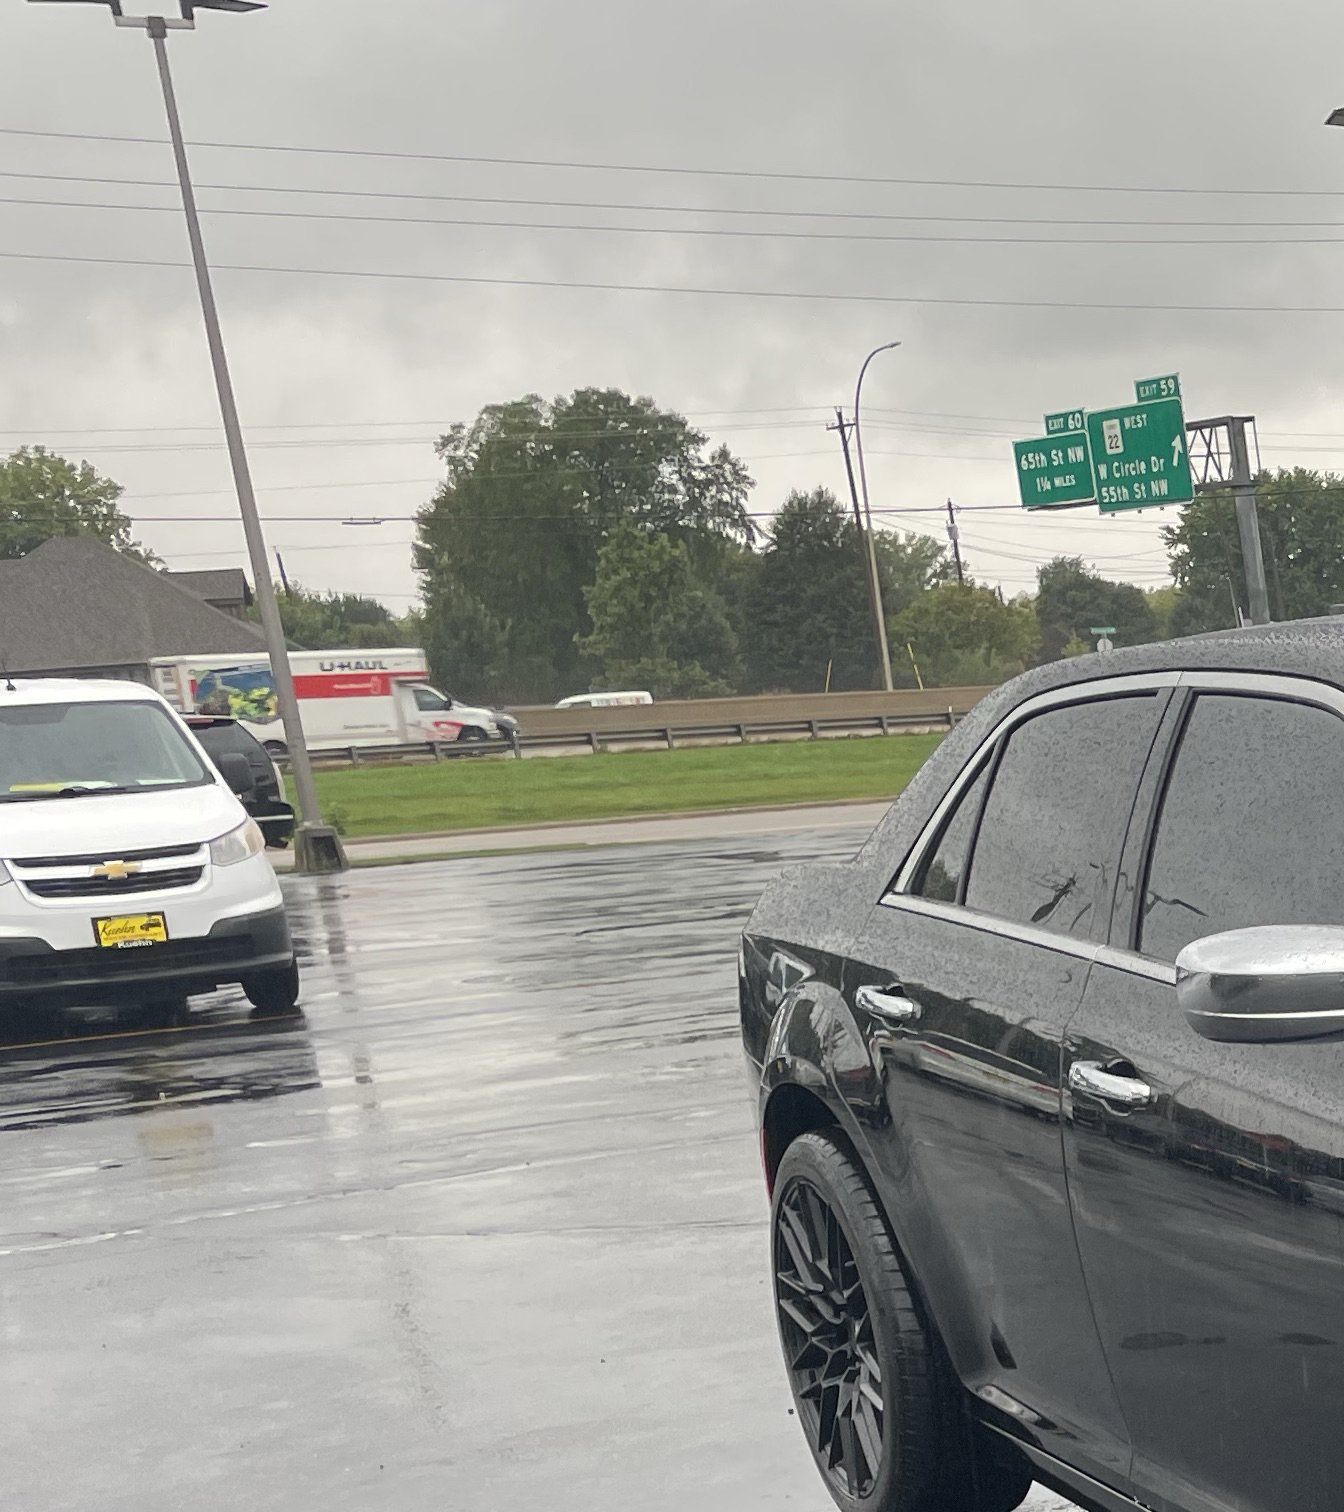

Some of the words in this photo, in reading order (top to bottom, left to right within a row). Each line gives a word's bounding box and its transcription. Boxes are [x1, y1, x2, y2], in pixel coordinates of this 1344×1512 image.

[1139, 384, 1157, 397] EXIT
[1159, 378, 1175, 396] 59
[1048, 418, 1064, 430] EXIT
[1067, 412, 1082, 429] 60
[1107, 434, 1120, 449] 22
[1123, 414, 1147, 430] WEST
[1020, 452, 1048, 471] 65th
[1050, 449, 1064, 466] St
[1067, 446, 1084, 464] NW
[1098, 463, 1107, 480] W
[1112, 459, 1147, 478] Circle
[1150, 456, 1164, 472] Dr
[1053, 474, 1076, 488] MILES
[1101, 485, 1130, 503] 55th
[1133, 482, 1147, 499] St
[1150, 479, 1169, 497] NW
